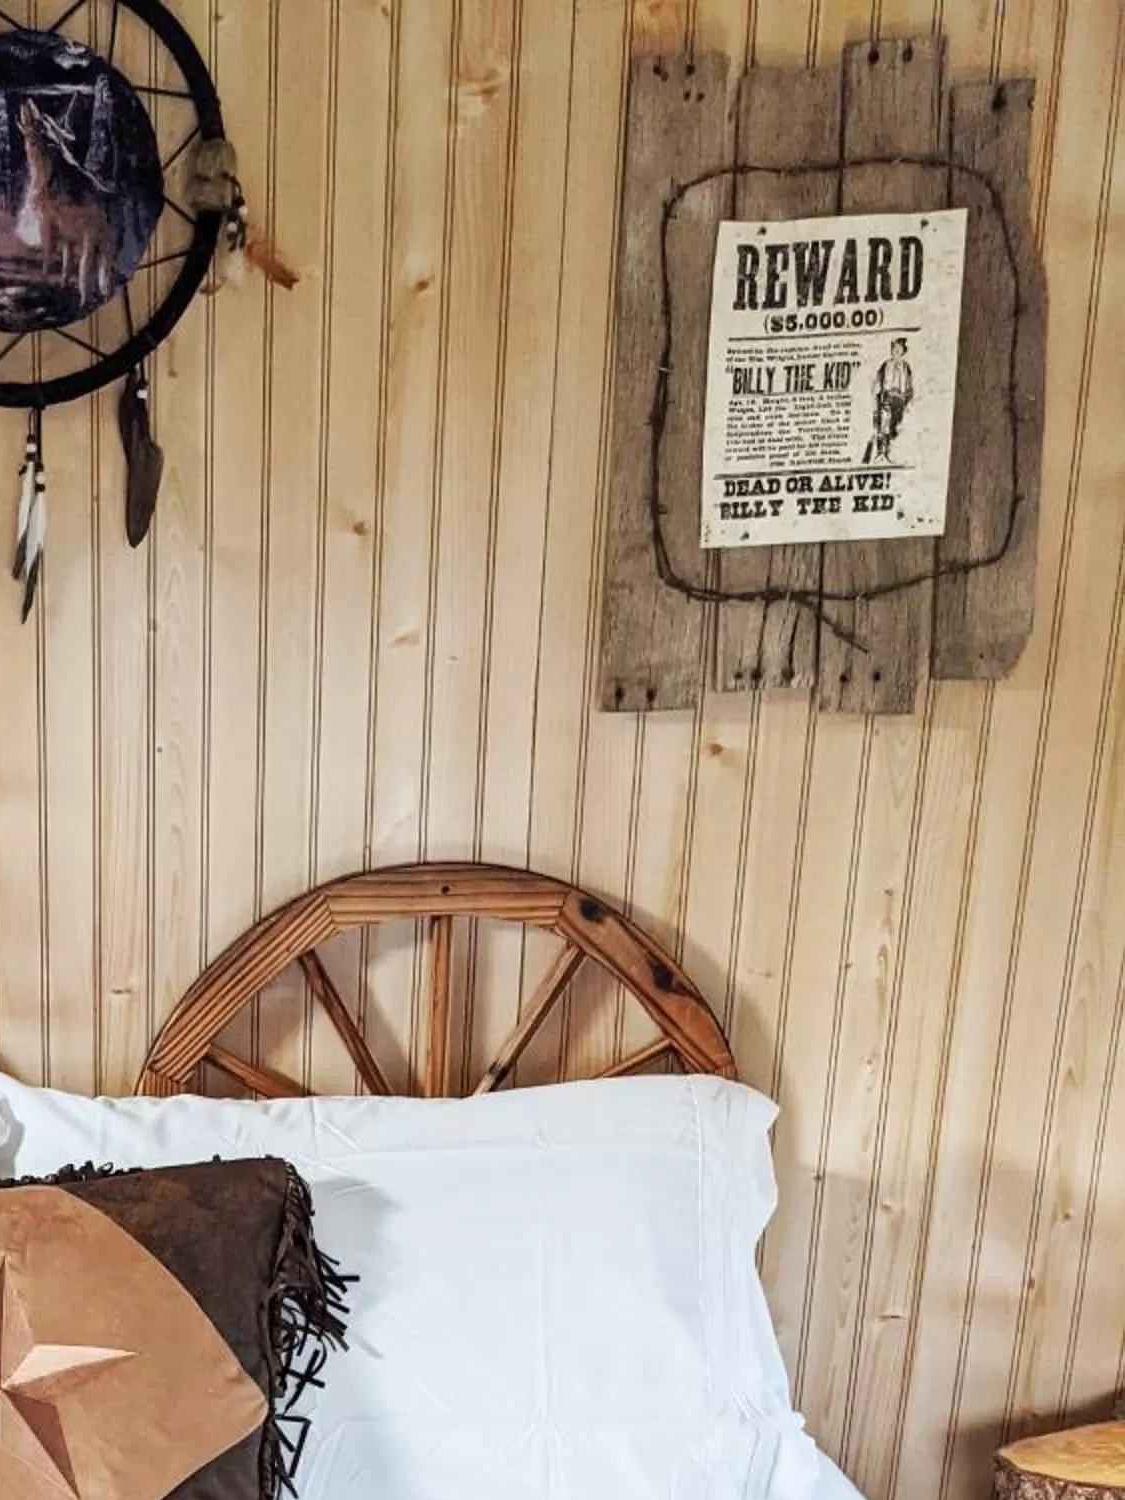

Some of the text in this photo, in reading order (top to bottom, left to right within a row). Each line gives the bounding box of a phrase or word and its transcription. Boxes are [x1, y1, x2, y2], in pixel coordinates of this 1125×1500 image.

[733, 236, 924, 310] REWARD
[783, 363, 816, 392] THE
[723, 472, 892, 497] DEAD OR ALIVE!
[796, 497, 842, 515] THE
